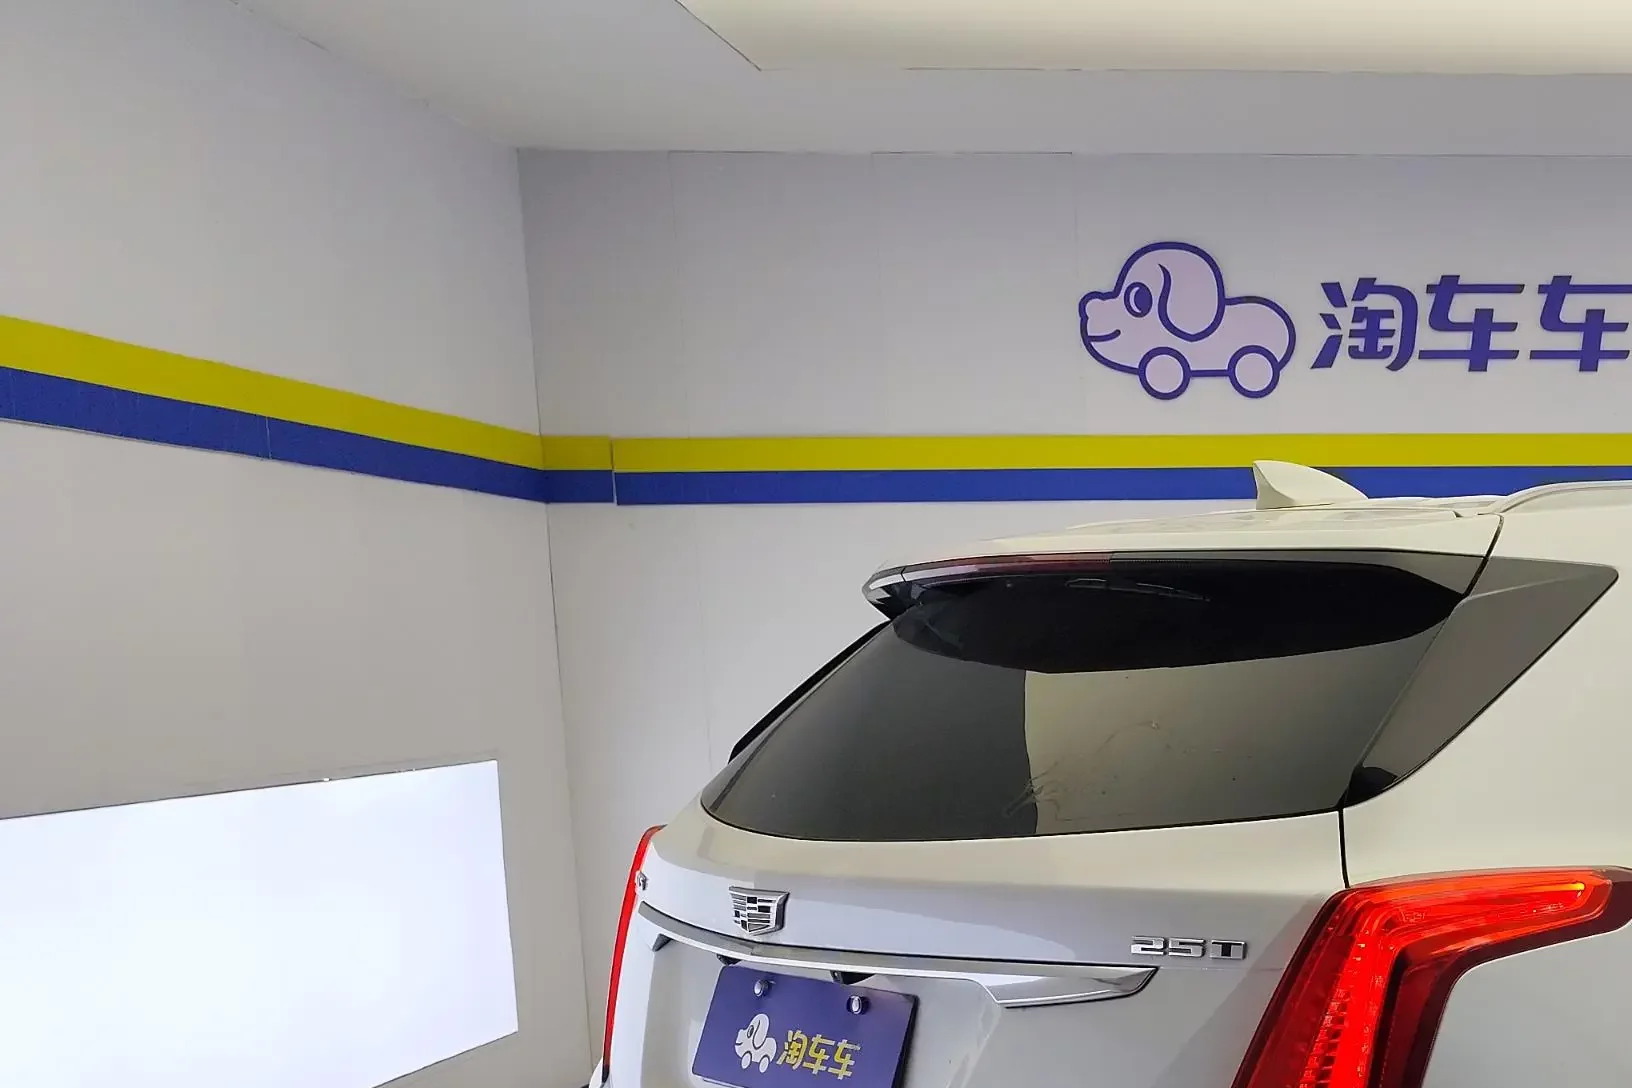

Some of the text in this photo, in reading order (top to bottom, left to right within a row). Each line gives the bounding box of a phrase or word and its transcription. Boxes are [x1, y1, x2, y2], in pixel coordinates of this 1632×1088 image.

[1130, 935, 1249, 961] 25T
[776, 1029, 861, 1081] 淘车车
